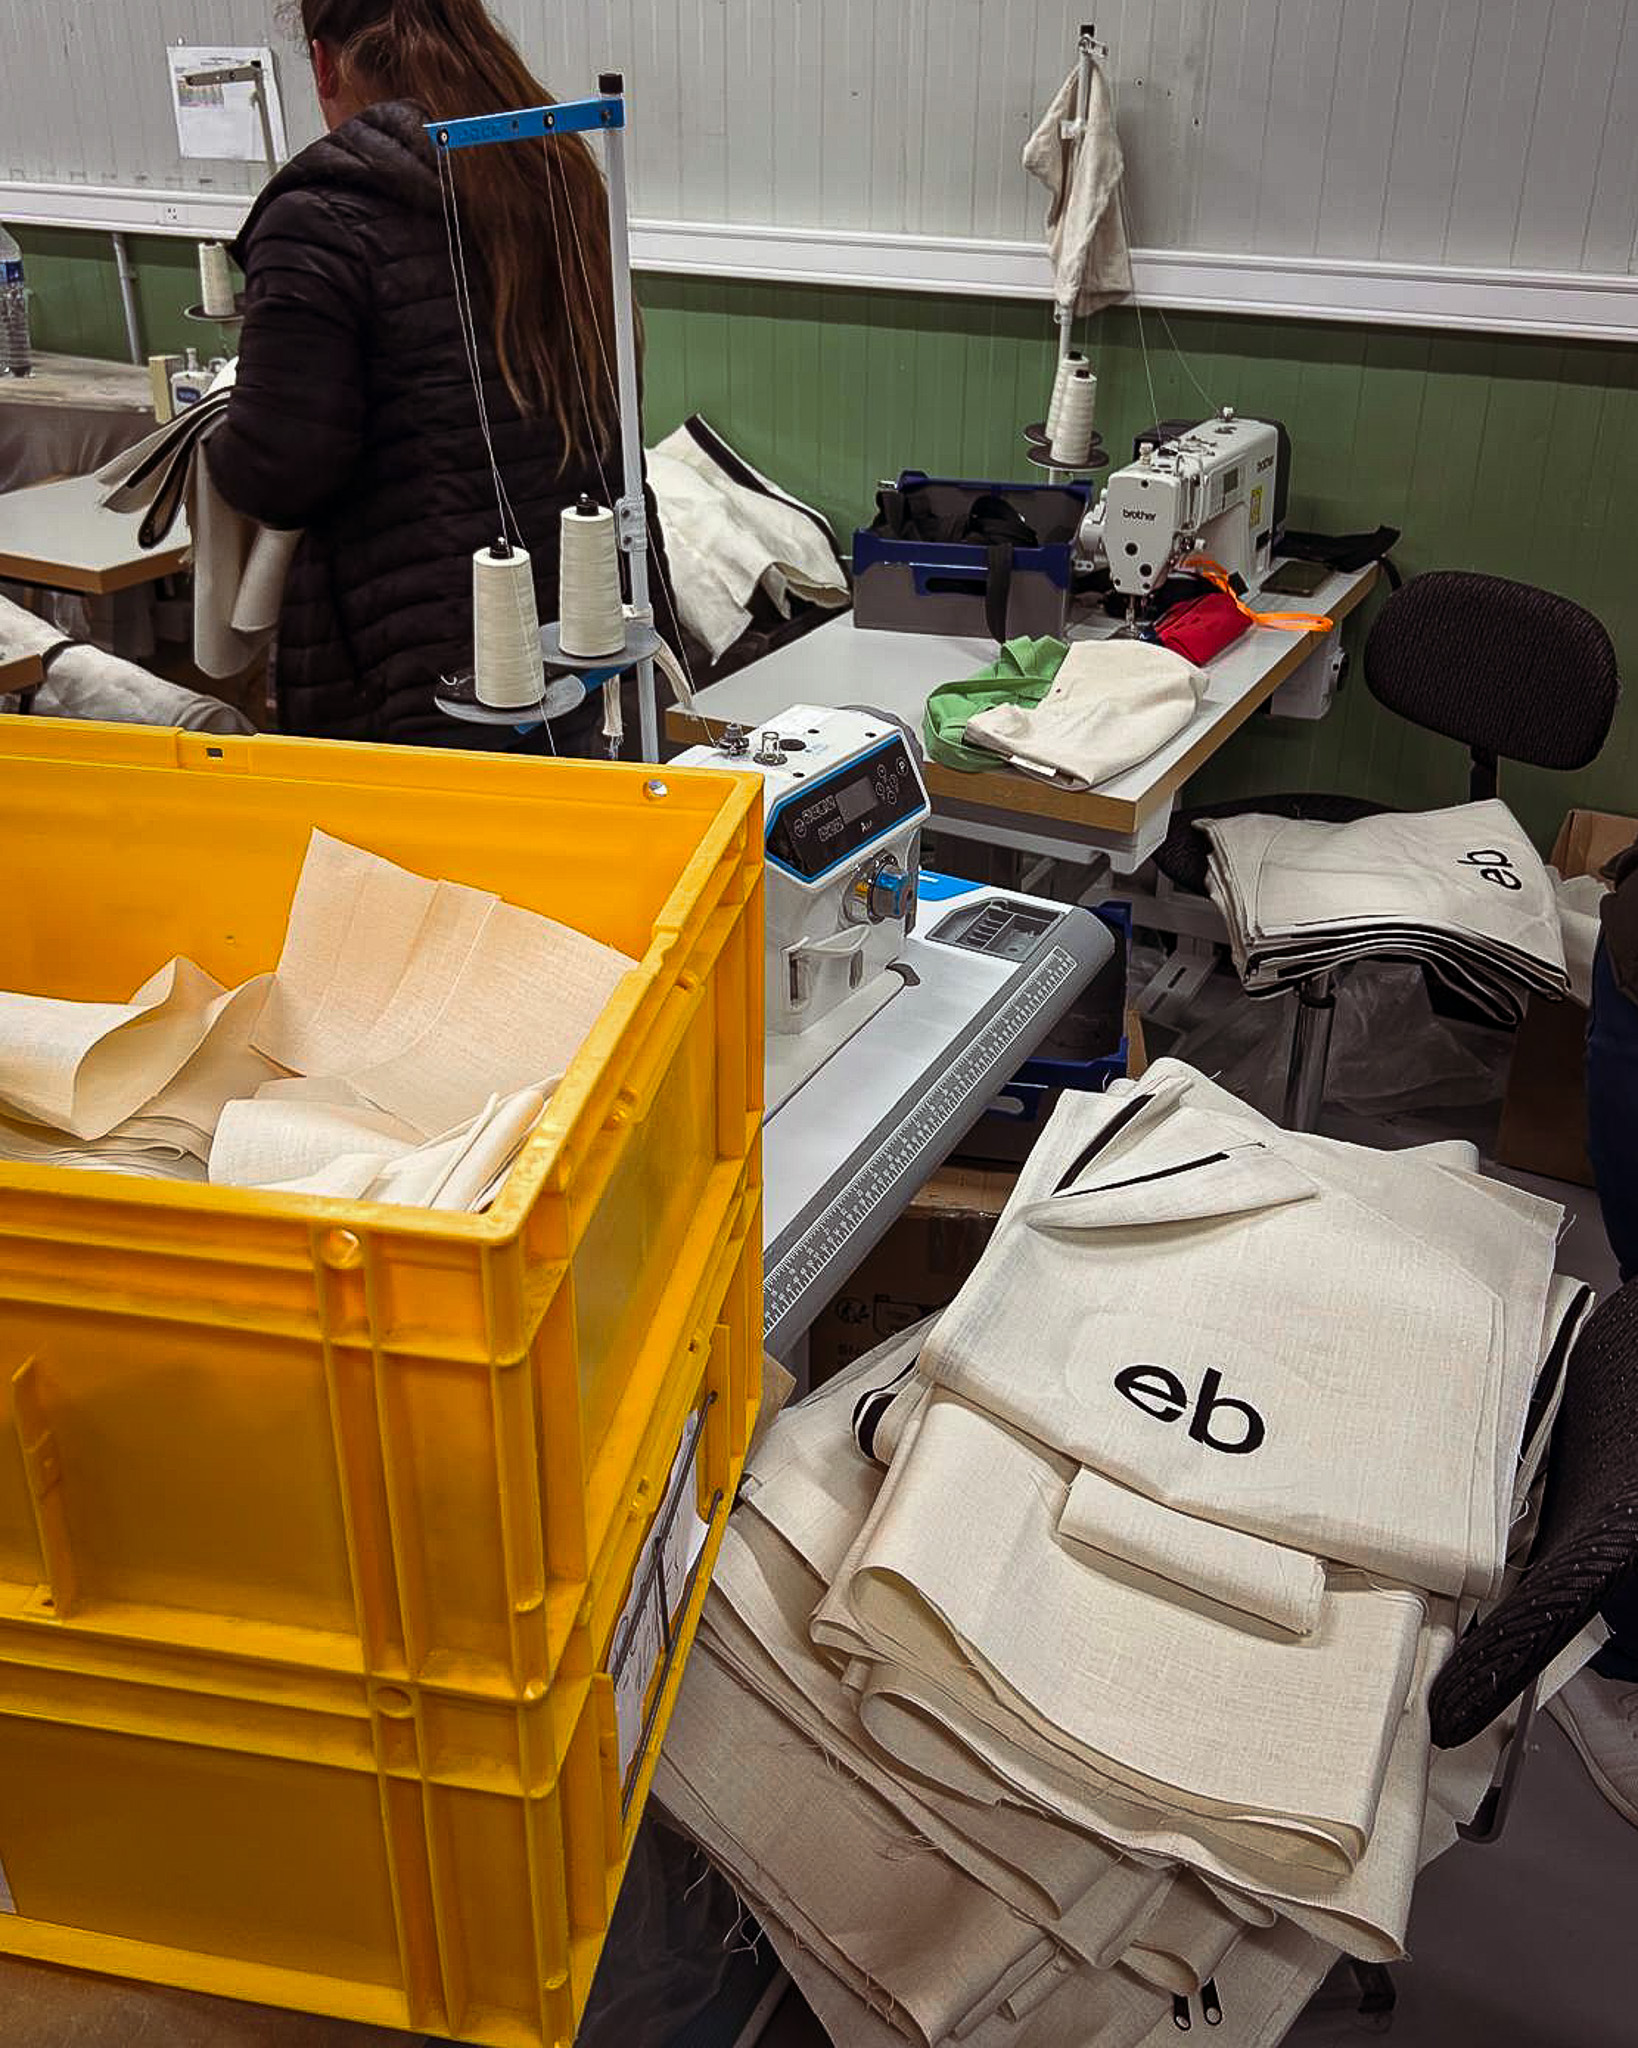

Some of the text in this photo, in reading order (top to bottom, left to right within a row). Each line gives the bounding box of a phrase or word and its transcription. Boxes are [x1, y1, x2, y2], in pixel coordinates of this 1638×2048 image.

[1122, 508, 1157, 521] brother
[1457, 850, 1522, 890] eb
[1114, 1365, 1265, 1454] eb
